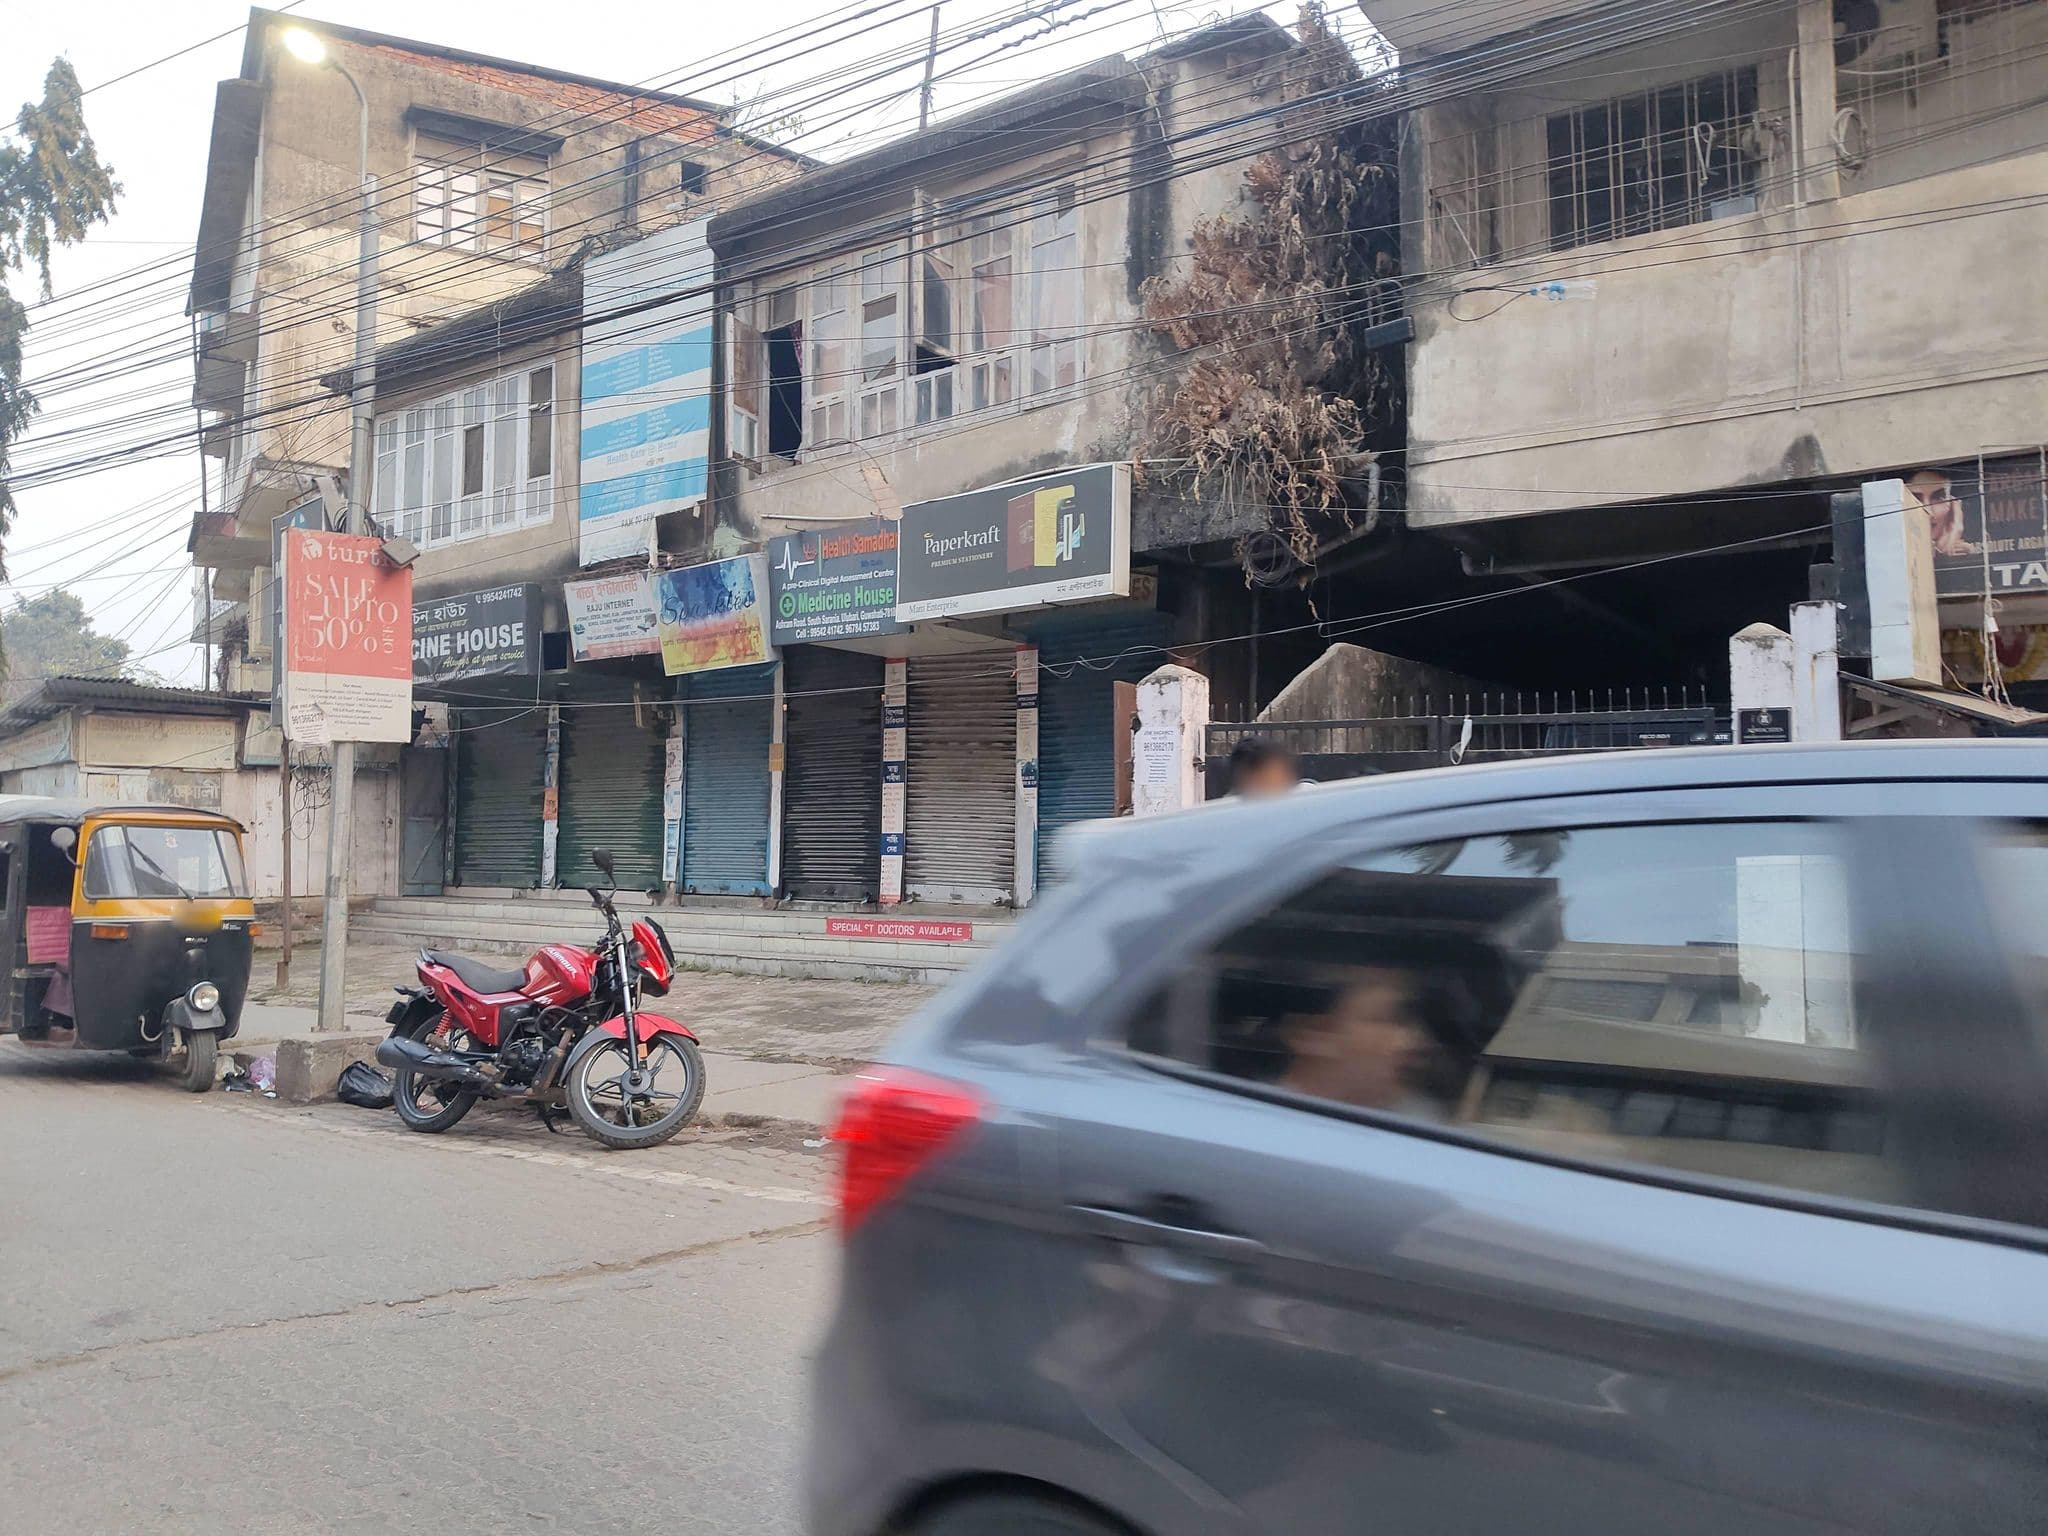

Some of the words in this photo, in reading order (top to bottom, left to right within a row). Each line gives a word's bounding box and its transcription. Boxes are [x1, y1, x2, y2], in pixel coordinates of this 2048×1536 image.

[822, 537, 851, 560] Health
[923, 524, 1000, 557] Paperkraft
[930, 557, 958, 569] PREMIUM
[958, 552, 994, 565] STATIONERY
[306, 573, 376, 600] SALE
[821, 575, 839, 587] Digital
[840, 571, 873, 583] Assessment
[586, 602, 602, 613] RAJU
[603, 598, 634, 611] INTERNET
[798, 588, 851, 614] Medicine
[854, 585, 894, 607] House
[308, 615, 378, 654] 50%
[456, 622, 525, 654] HOUSE
[877, 924, 915, 936] DOCTORS
